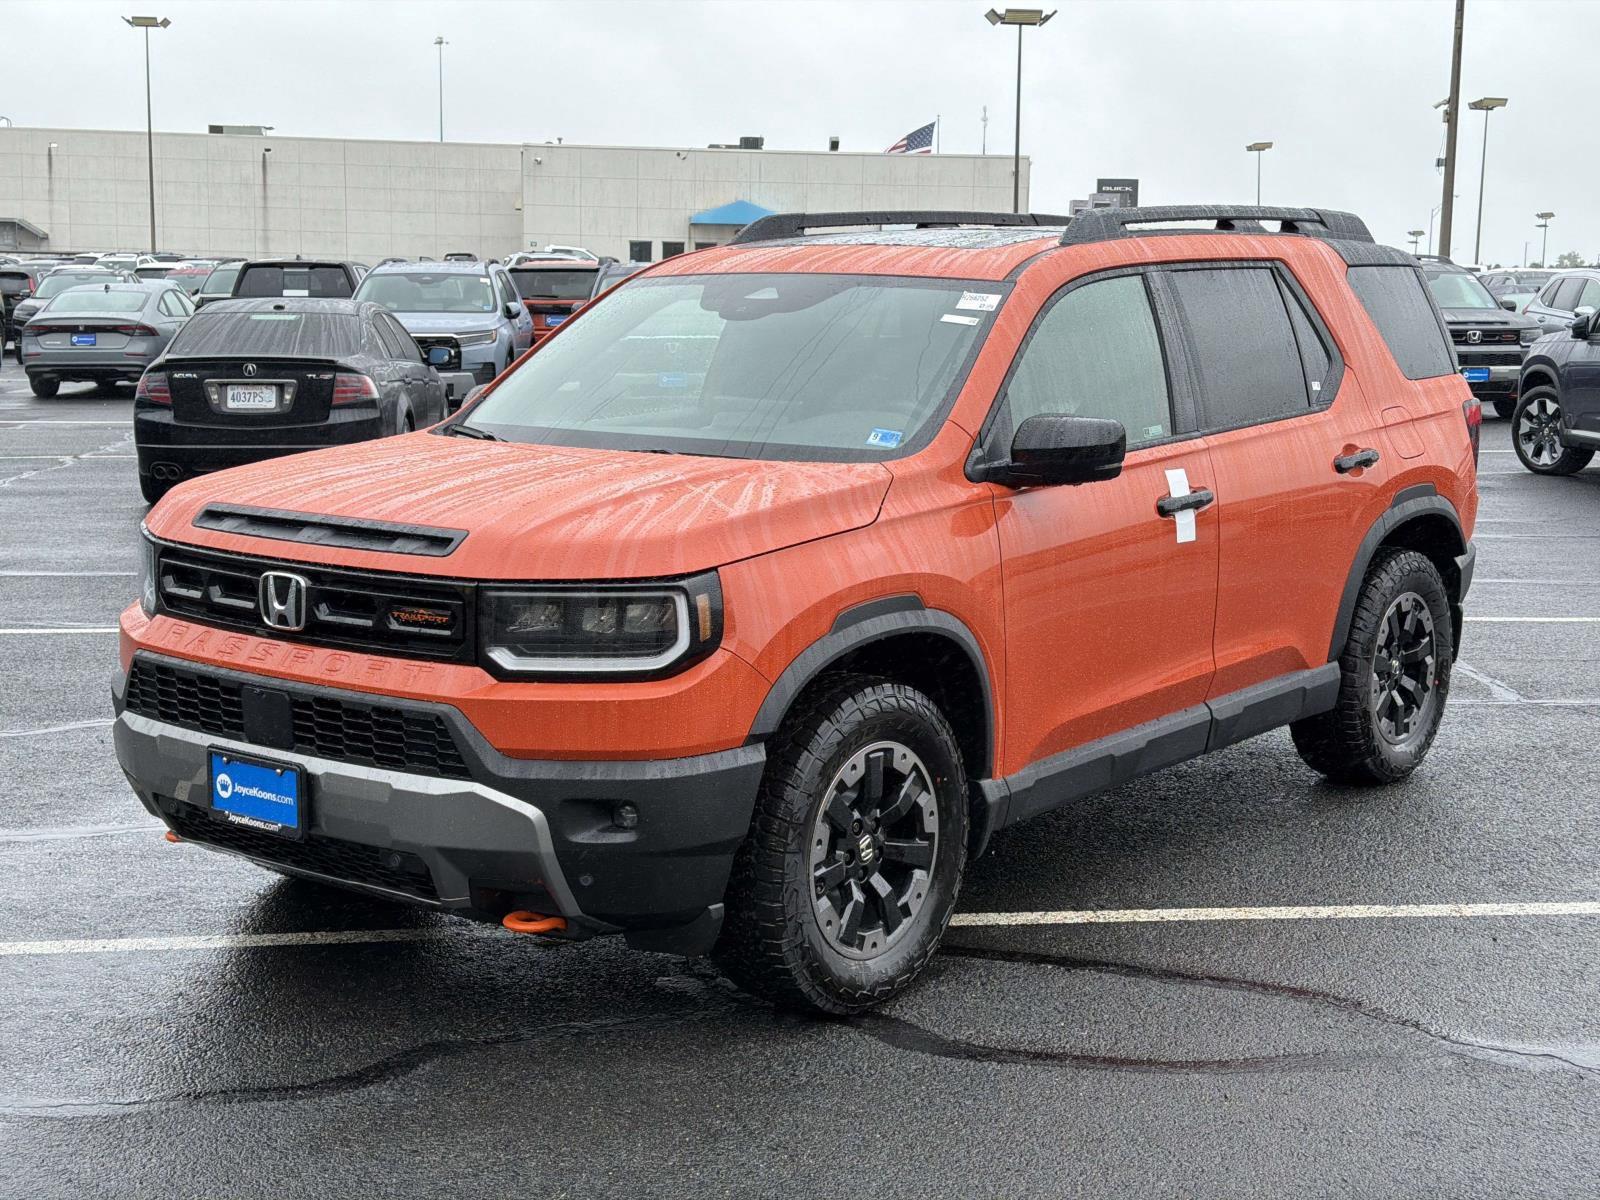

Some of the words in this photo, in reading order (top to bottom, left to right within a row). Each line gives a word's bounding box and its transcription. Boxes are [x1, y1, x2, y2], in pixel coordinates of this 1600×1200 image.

[230, 391, 264, 403] 4037PS
[158, 622, 435, 687] PASSPORT
[234, 782, 294, 806] JoyceKoons.com
[228, 812, 279, 832] JoyceKoons.com
